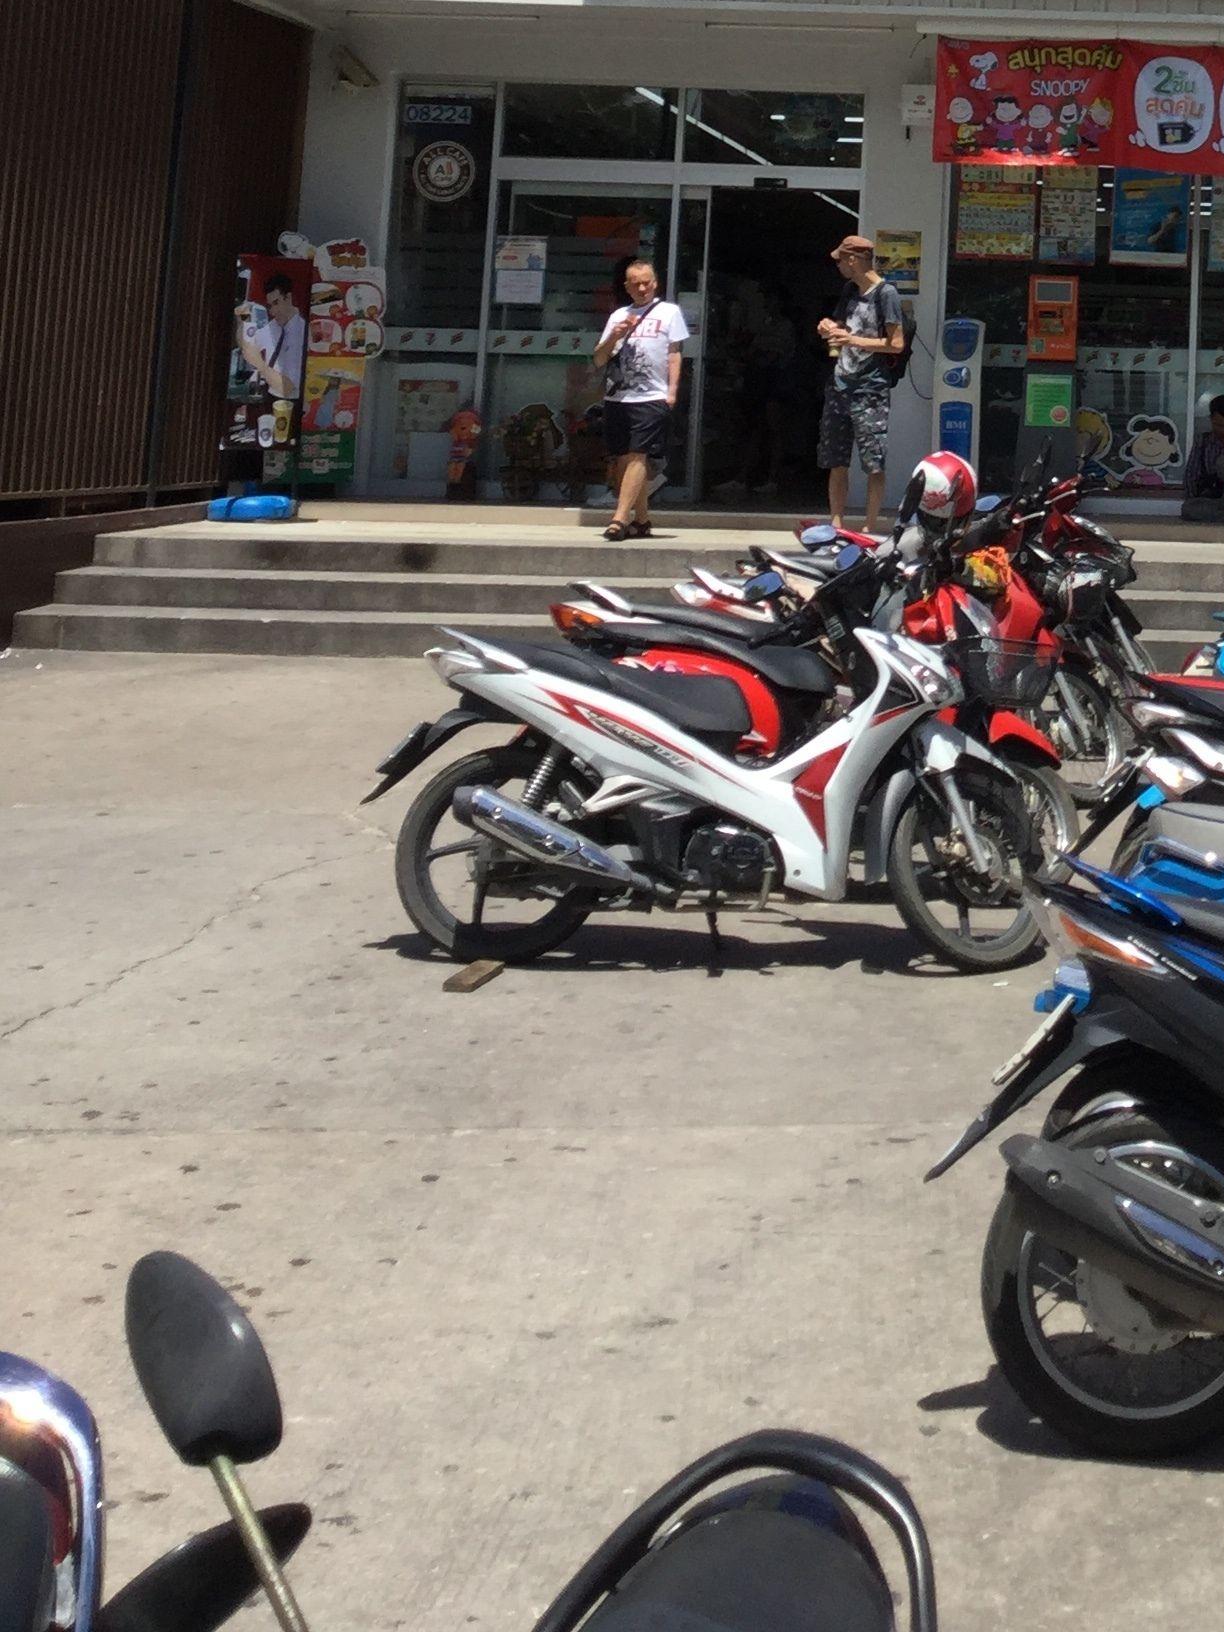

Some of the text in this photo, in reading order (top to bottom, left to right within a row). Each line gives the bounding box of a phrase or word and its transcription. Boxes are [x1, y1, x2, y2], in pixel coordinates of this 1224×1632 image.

[1007, 44, 1124, 73] สนุกสุดคุ้ม
[1030, 77, 1090, 97] SNOOPY
[406, 106, 470, 122] 08224
